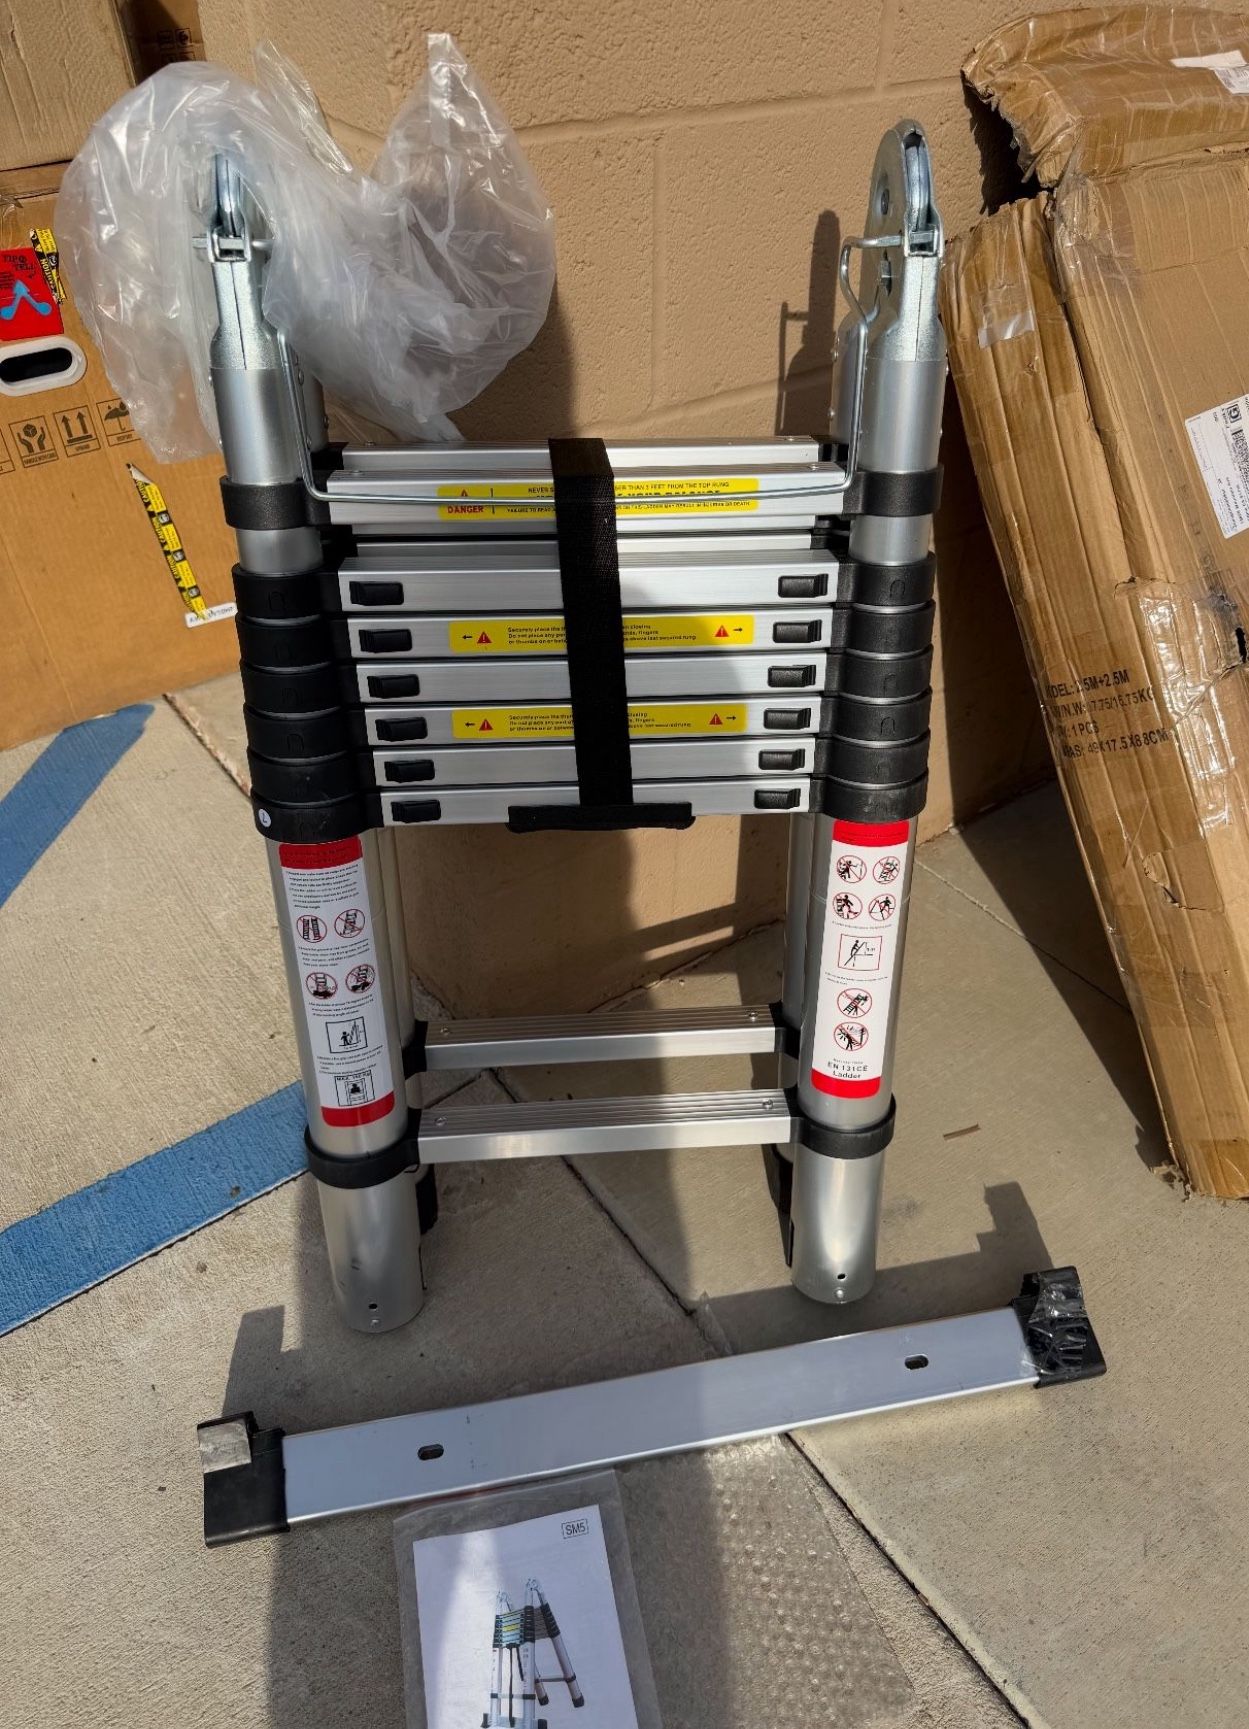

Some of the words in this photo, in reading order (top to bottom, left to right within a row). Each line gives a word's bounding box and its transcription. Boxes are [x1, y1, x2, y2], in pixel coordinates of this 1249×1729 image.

[447, 505, 484, 514] DANGER
[827, 1061, 839, 1070] EN
[832, 1070, 861, 1079] Ladder
[565, 1522, 586, 1536] SM5
